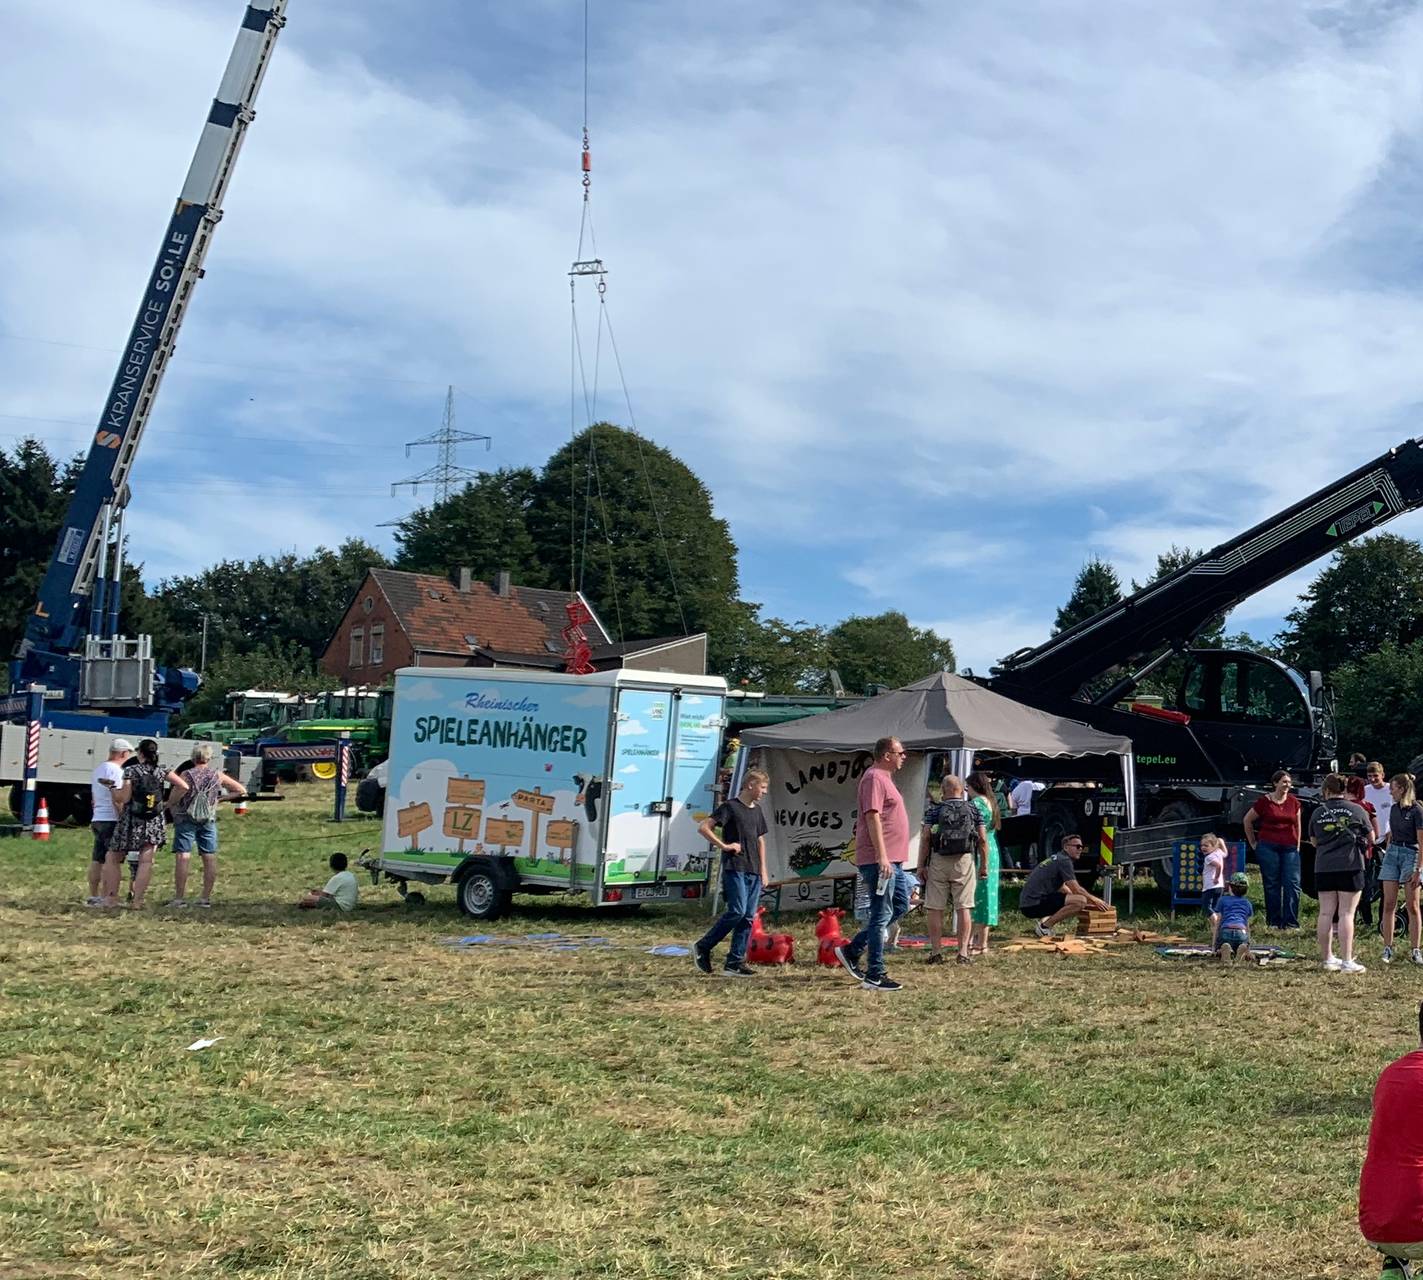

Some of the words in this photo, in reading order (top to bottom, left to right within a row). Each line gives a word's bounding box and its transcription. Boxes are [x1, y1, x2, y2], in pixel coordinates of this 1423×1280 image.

[107, 299, 165, 428] KRANSERVICE
[465, 692, 540, 712] Rheinischer
[414, 715, 588, 757] SPIELEANHÄNGER
[1136, 754, 1177, 766] tepel.eu
[452, 811, 474, 832] LZ
